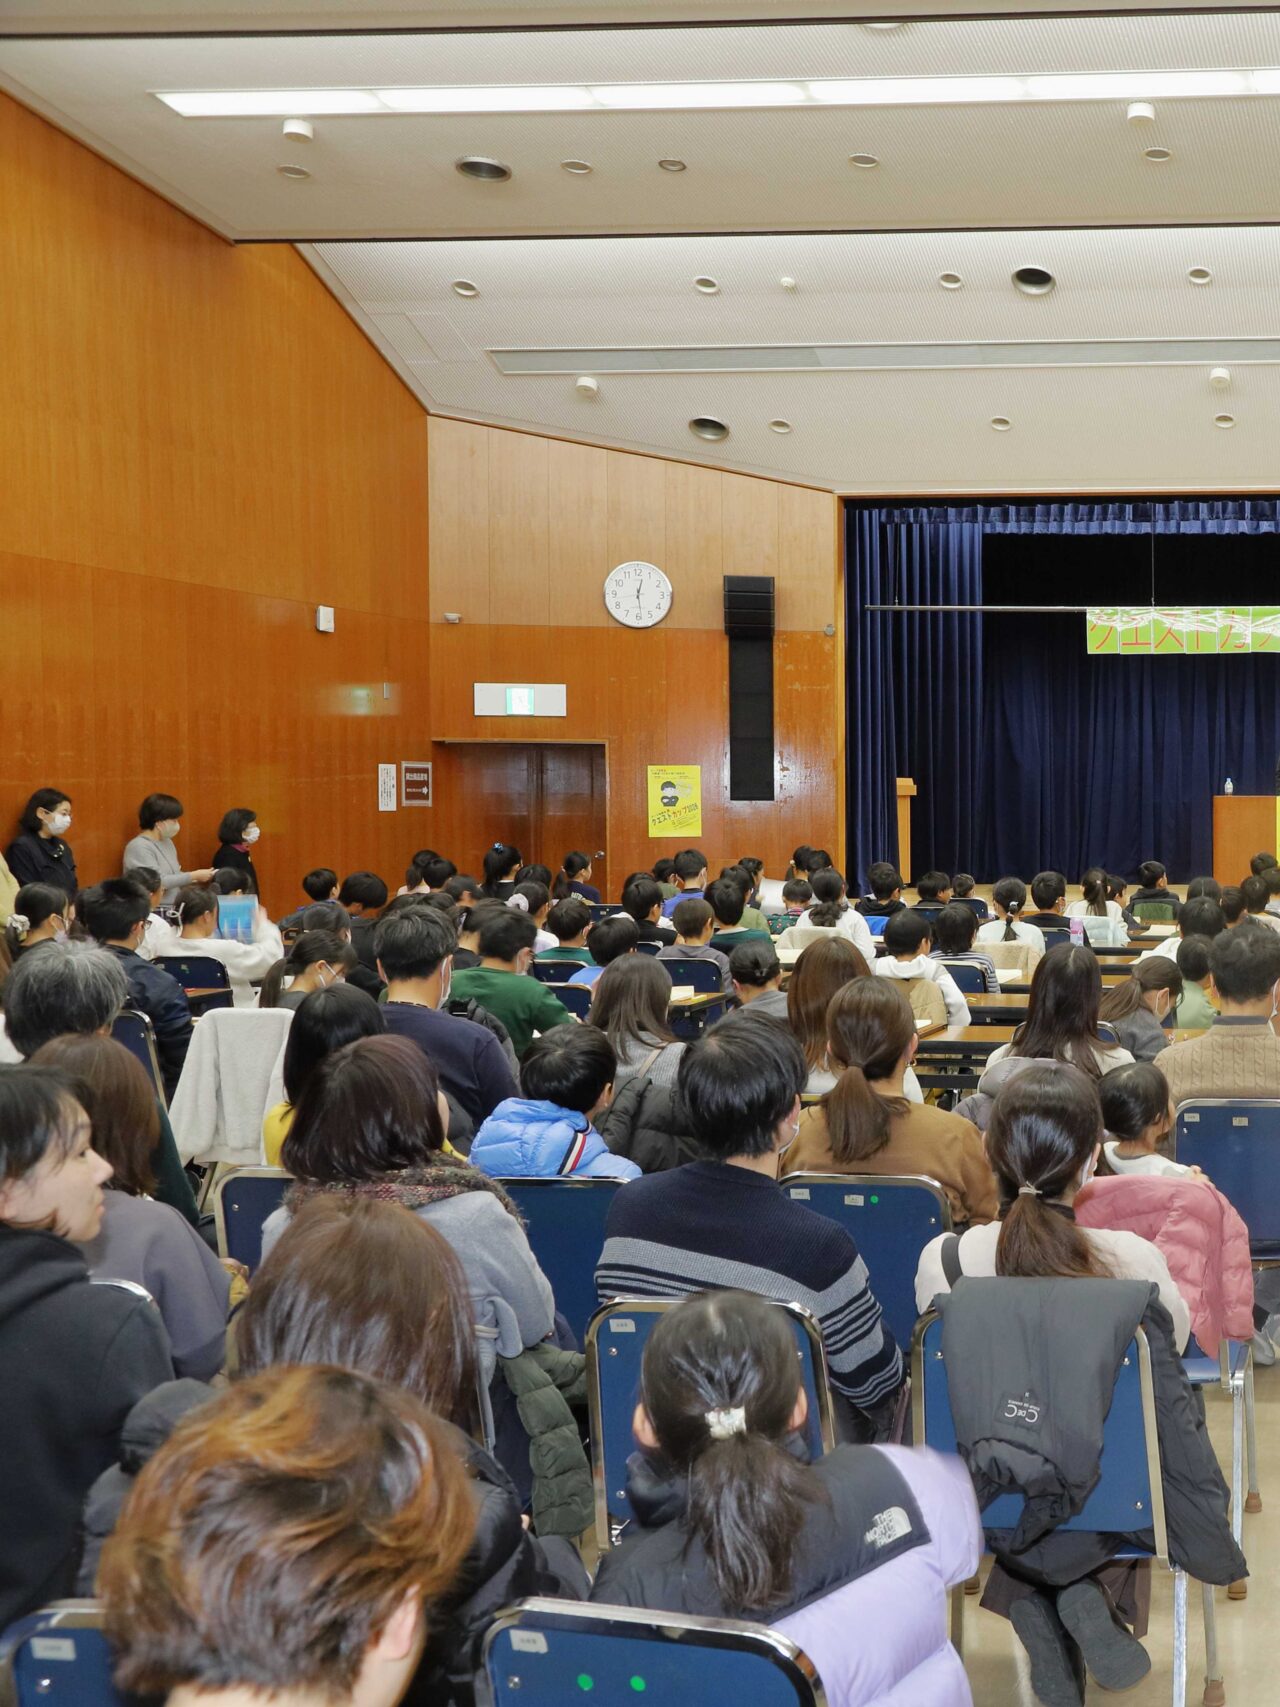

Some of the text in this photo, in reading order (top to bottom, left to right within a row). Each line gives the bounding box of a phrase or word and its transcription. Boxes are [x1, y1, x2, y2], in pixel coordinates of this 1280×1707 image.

[623, 571, 631, 579] 11
[634, 568, 643, 577] 12
[615, 579, 624, 588] 10
[656, 580, 661, 588] 2
[611, 590, 617, 598] 9
[615, 601, 621, 609] 8
